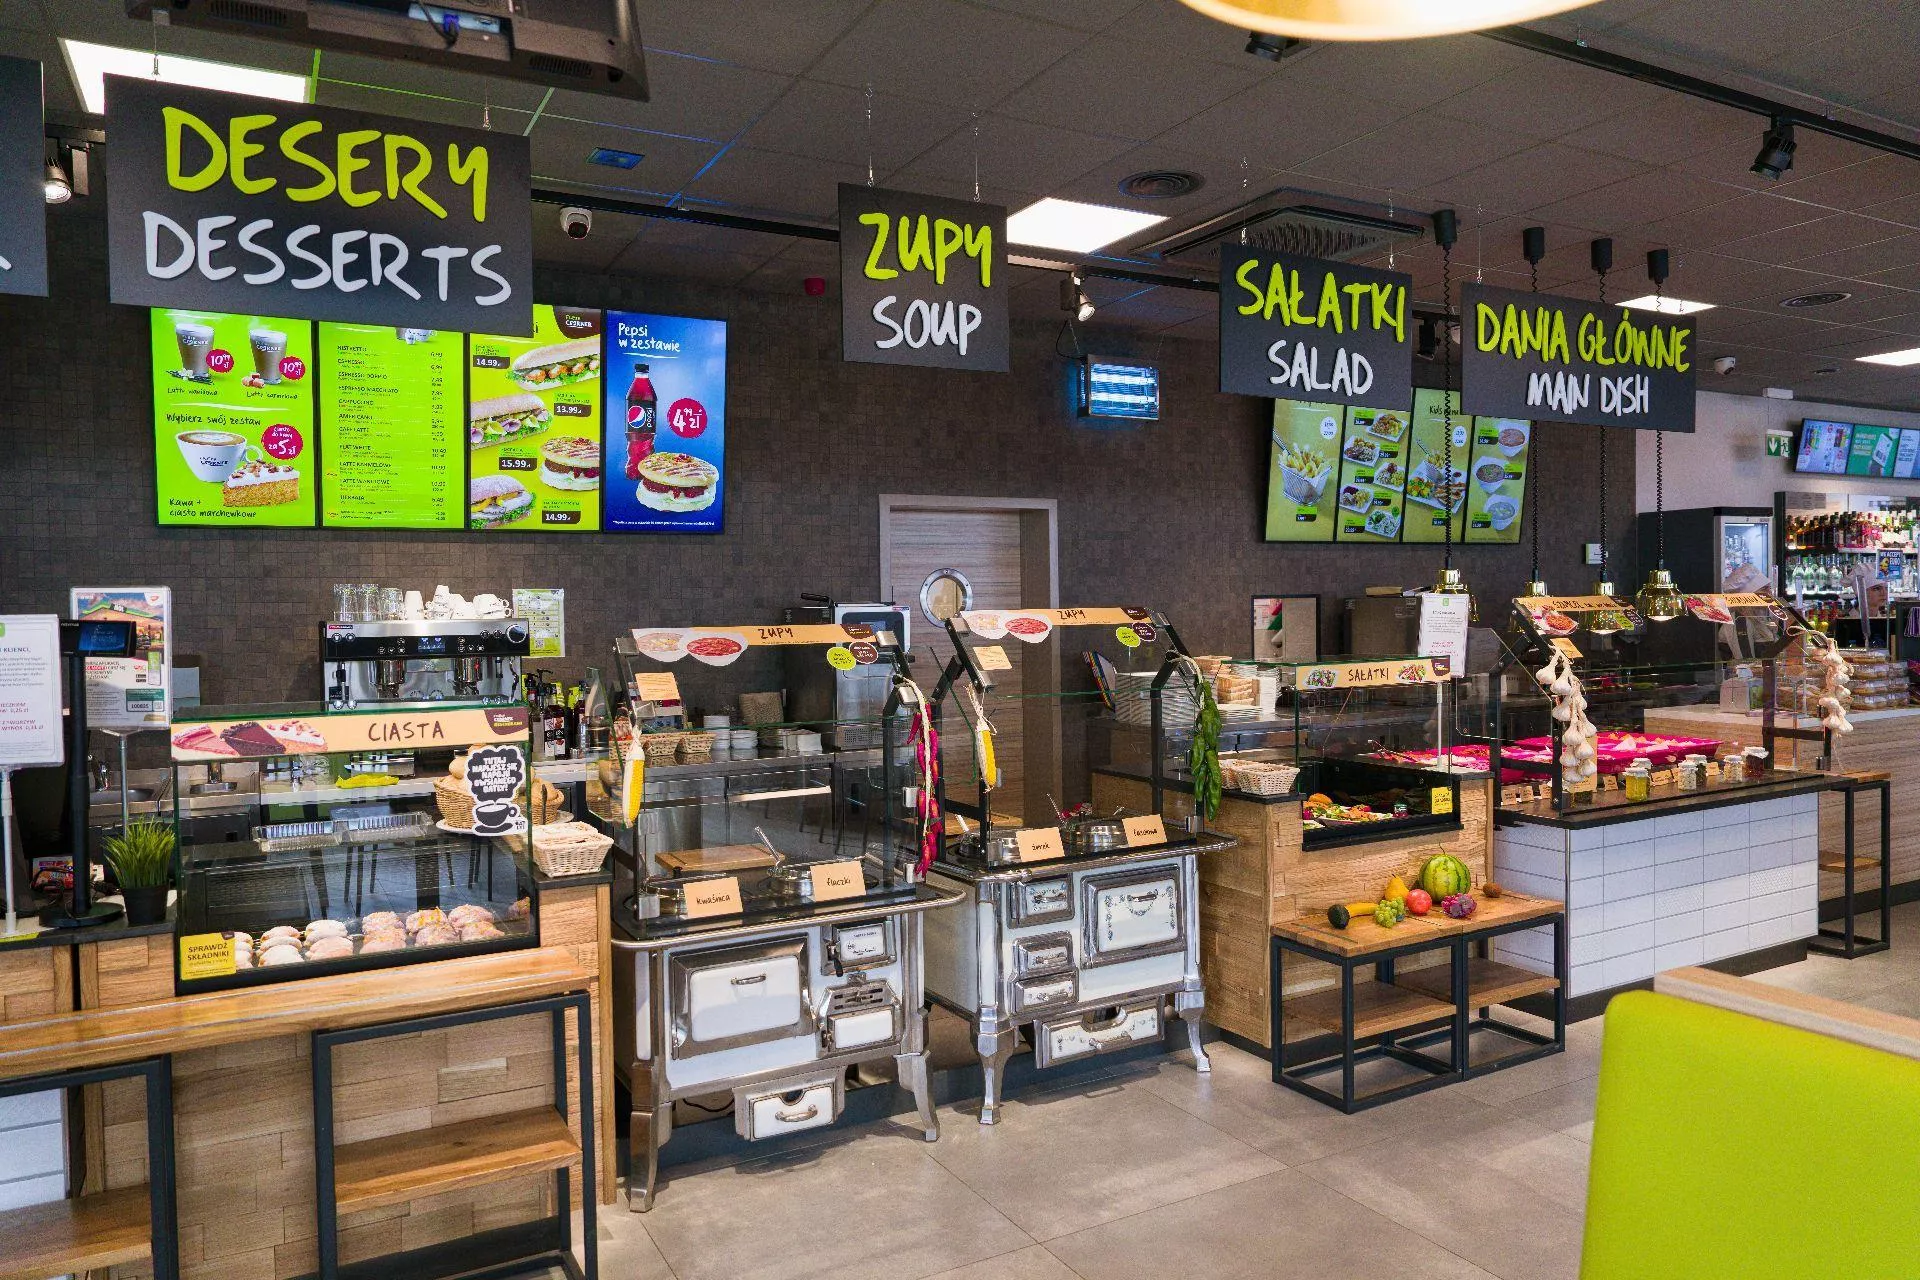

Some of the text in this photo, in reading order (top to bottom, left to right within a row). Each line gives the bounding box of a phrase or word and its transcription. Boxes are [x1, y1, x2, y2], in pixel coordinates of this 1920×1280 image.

[162, 107, 489, 222] DESERY
[859, 213, 992, 288] ZUPY
[142, 211, 512, 306] DESSERTS
[1236, 259, 1405, 342] SAŁATKI
[619, 323, 648, 339] Pepsi
[873, 296, 982, 355] SOUP
[1477, 303, 1690, 372] DANIA GŁÓWNE
[619, 338, 680, 352] w zestawie
[210, 355, 223, 366] 10
[283, 361, 294, 373] 10
[1268, 340, 1374, 396] SALAD
[1600, 373, 1648, 416] DISH
[556, 405, 578, 414] 13.99
[1429, 404, 1443, 415] Kids
[166, 413, 261, 426] Wybierz swój zestaw
[673, 408, 687, 432] 4
[278, 439, 289, 454] 5
[501, 459, 527, 468] 15.99
[169, 498, 194, 507] Kawa
[170, 508, 256, 518] ciasto marchewkowe
[545, 513, 568, 521] 14.99
[1057, 609, 1086, 620] ZUPY
[758, 627, 793, 639] ZUPY
[1348, 668, 1389, 681] SAŁATKI
[368, 720, 444, 741] CIASTA
[483, 756, 507, 765] TUTAJ
[188, 942, 228, 953] SPRAWDŹ
[187, 950, 229, 961] SKŁADNIKI
